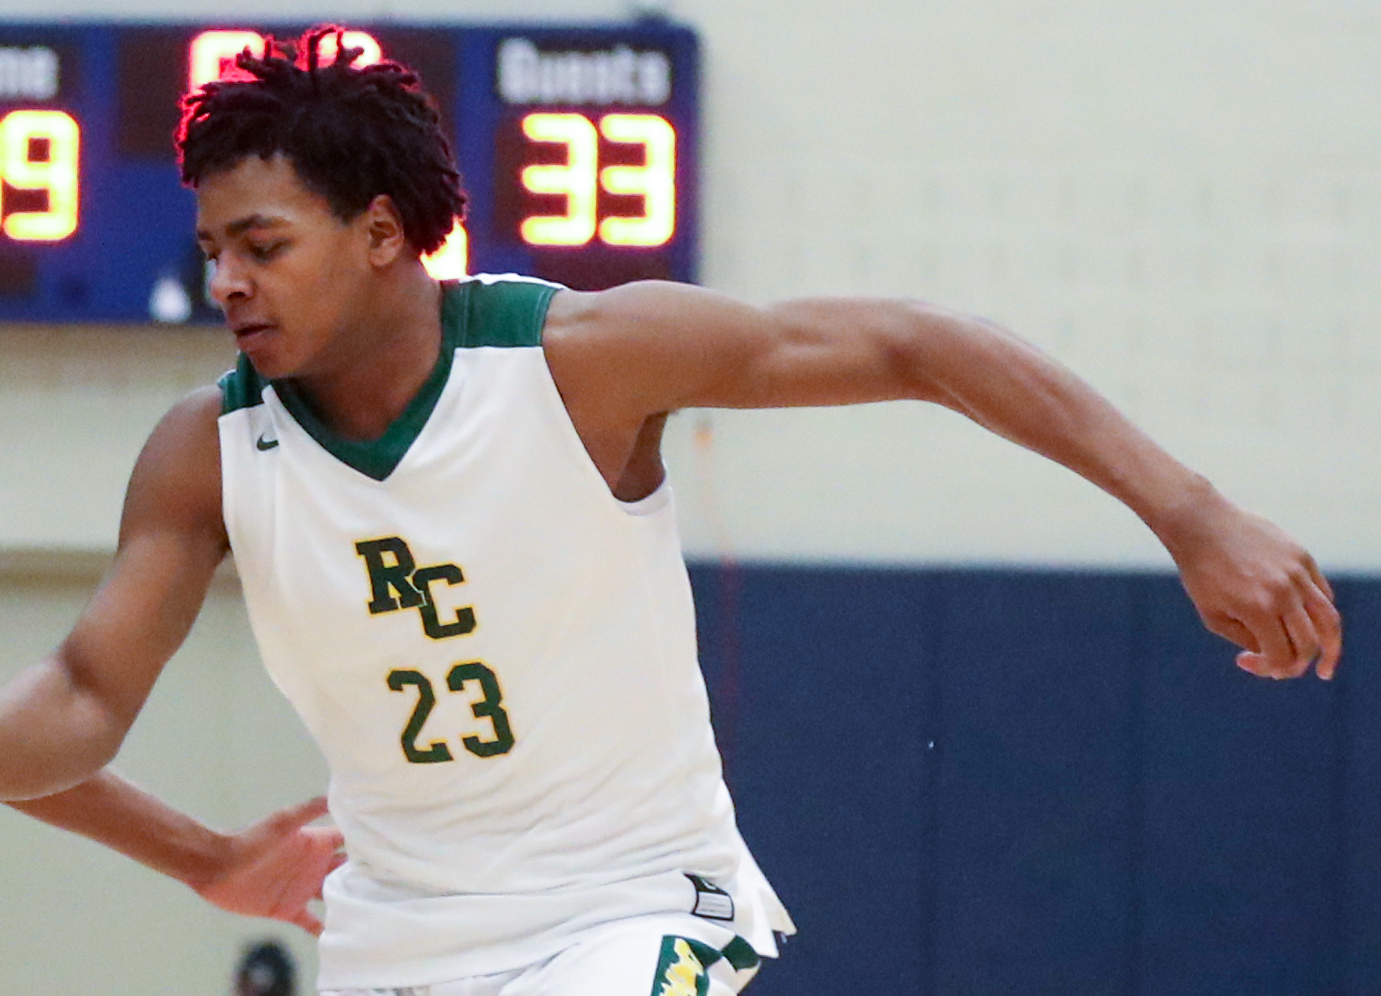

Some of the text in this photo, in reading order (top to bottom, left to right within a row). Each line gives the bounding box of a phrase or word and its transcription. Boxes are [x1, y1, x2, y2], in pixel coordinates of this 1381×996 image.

[498, 38, 670, 104] Guests
[521, 112, 675, 246] 33
[355, 536, 477, 639] RC
[386, 660, 515, 764] 23
